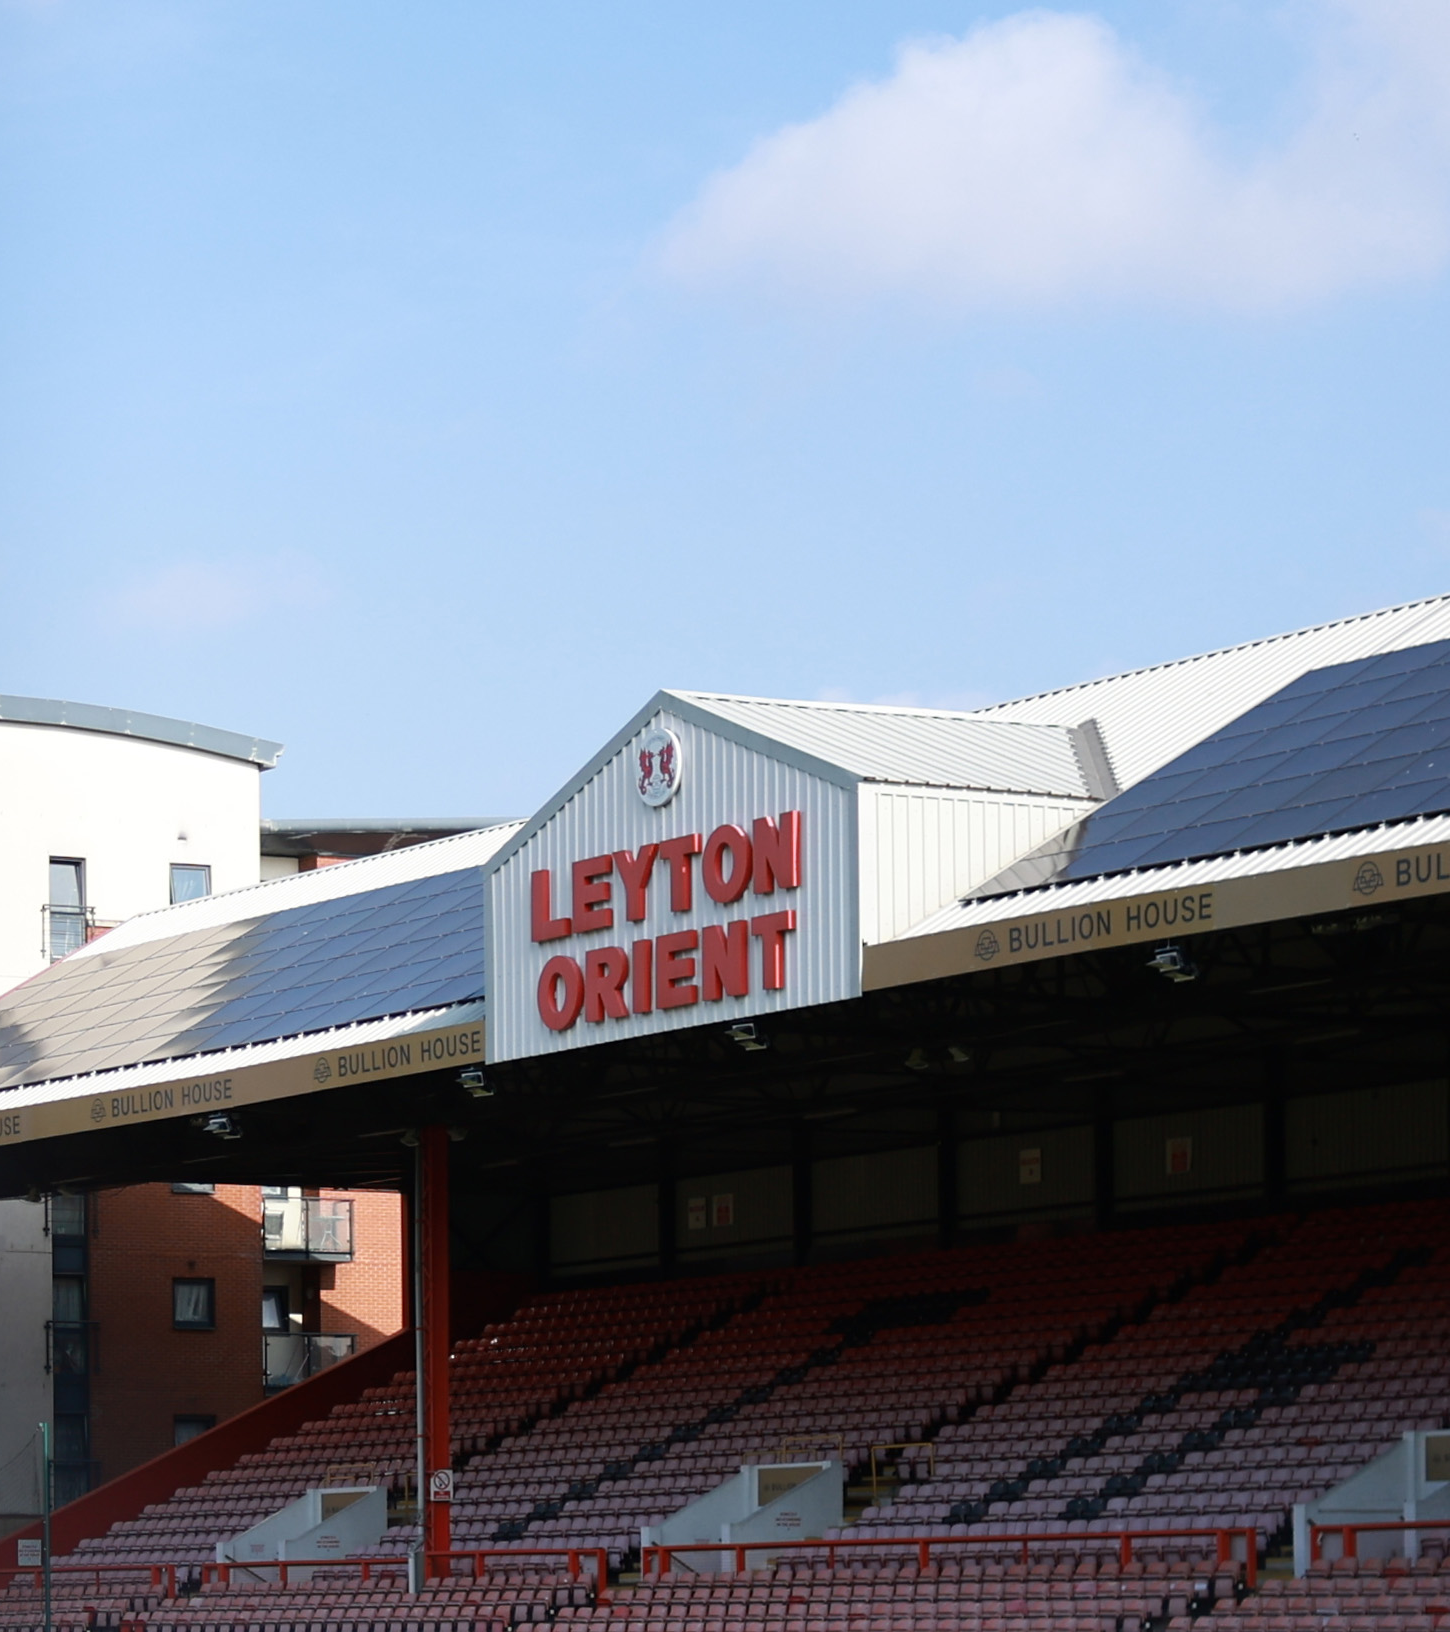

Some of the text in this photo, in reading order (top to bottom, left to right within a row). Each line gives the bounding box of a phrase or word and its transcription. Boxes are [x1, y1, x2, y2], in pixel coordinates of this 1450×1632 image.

[531, 809, 801, 944] LEYTON
[1009, 893, 1212, 953] BULLION HOUSE
[538, 909, 796, 1032] ORIENT
[338, 1031, 481, 1077] BULLION HOUSE
[111, 1079, 232, 1117] BULLION HOUSE
